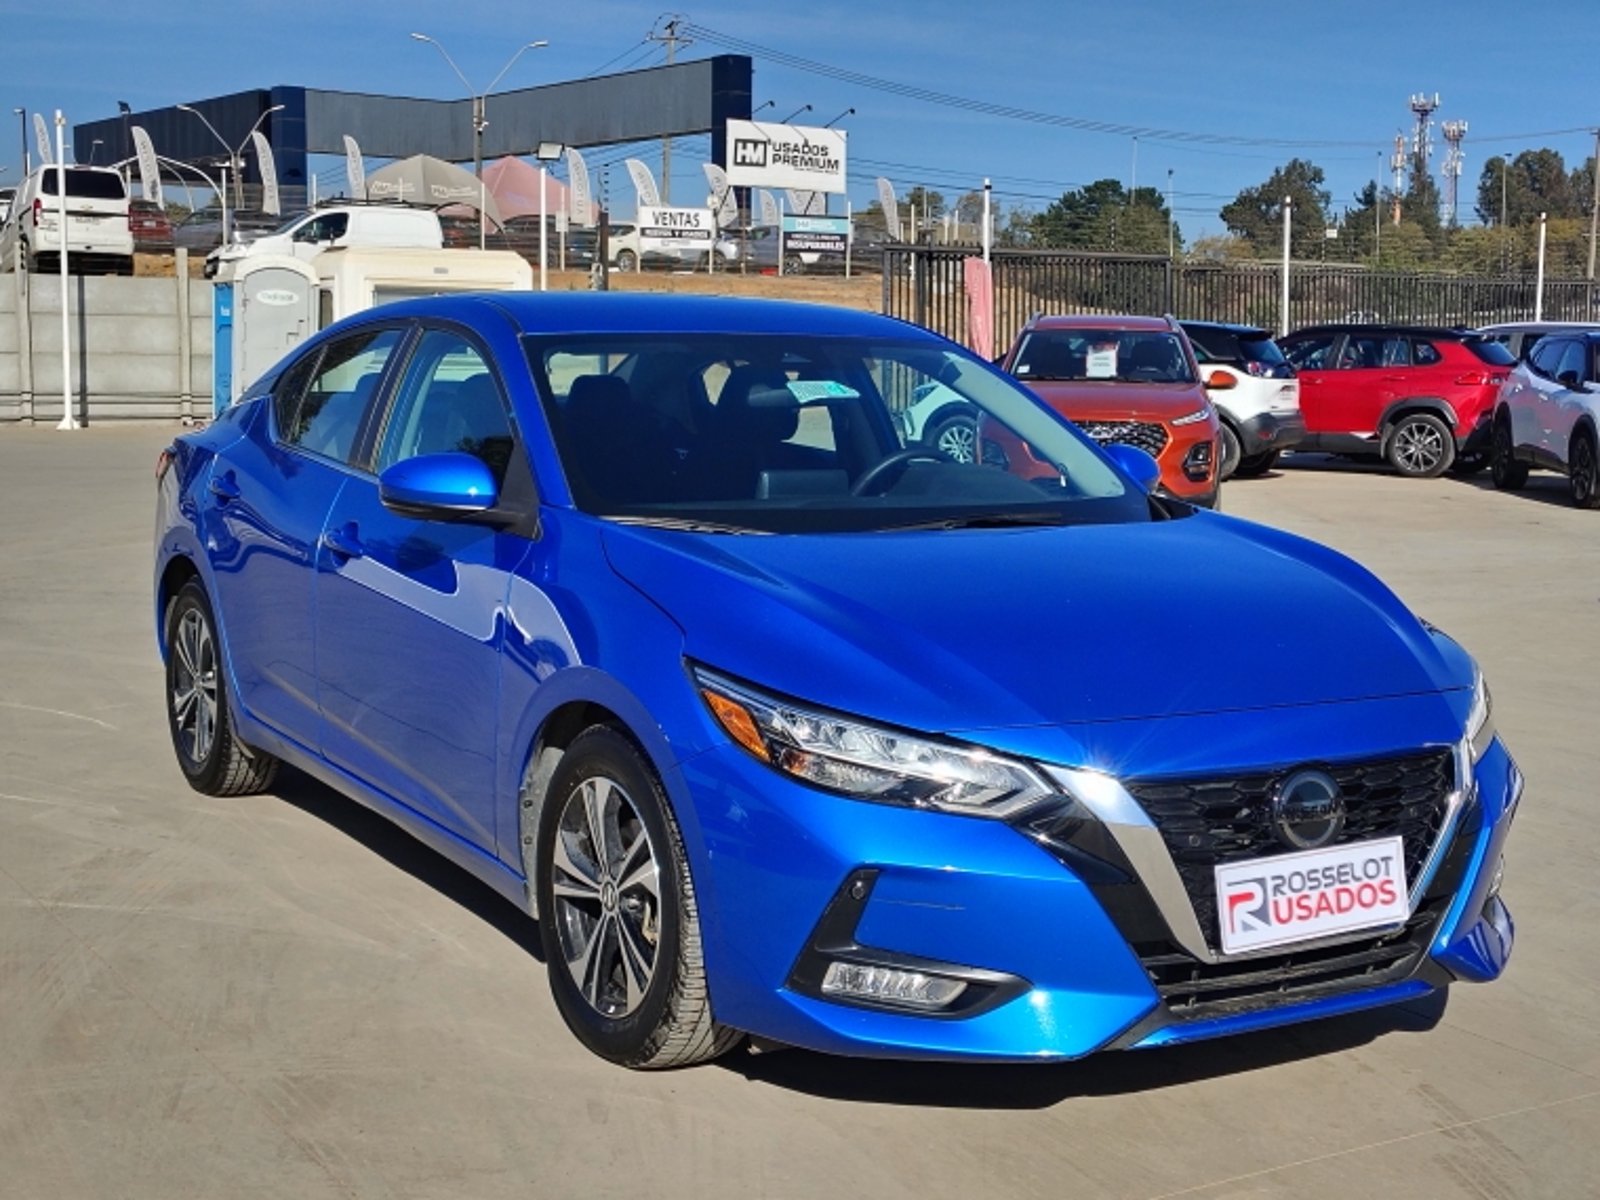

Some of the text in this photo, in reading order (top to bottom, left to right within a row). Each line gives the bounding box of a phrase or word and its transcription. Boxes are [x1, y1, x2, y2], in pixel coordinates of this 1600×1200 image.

[735, 139, 829, 166] HM USADOS
[772, 153, 839, 170] PREMIUM
[652, 211, 700, 228] VENTAS
[1271, 856, 1394, 897] ROSSELOT
[1273, 879, 1397, 925] USADOS
